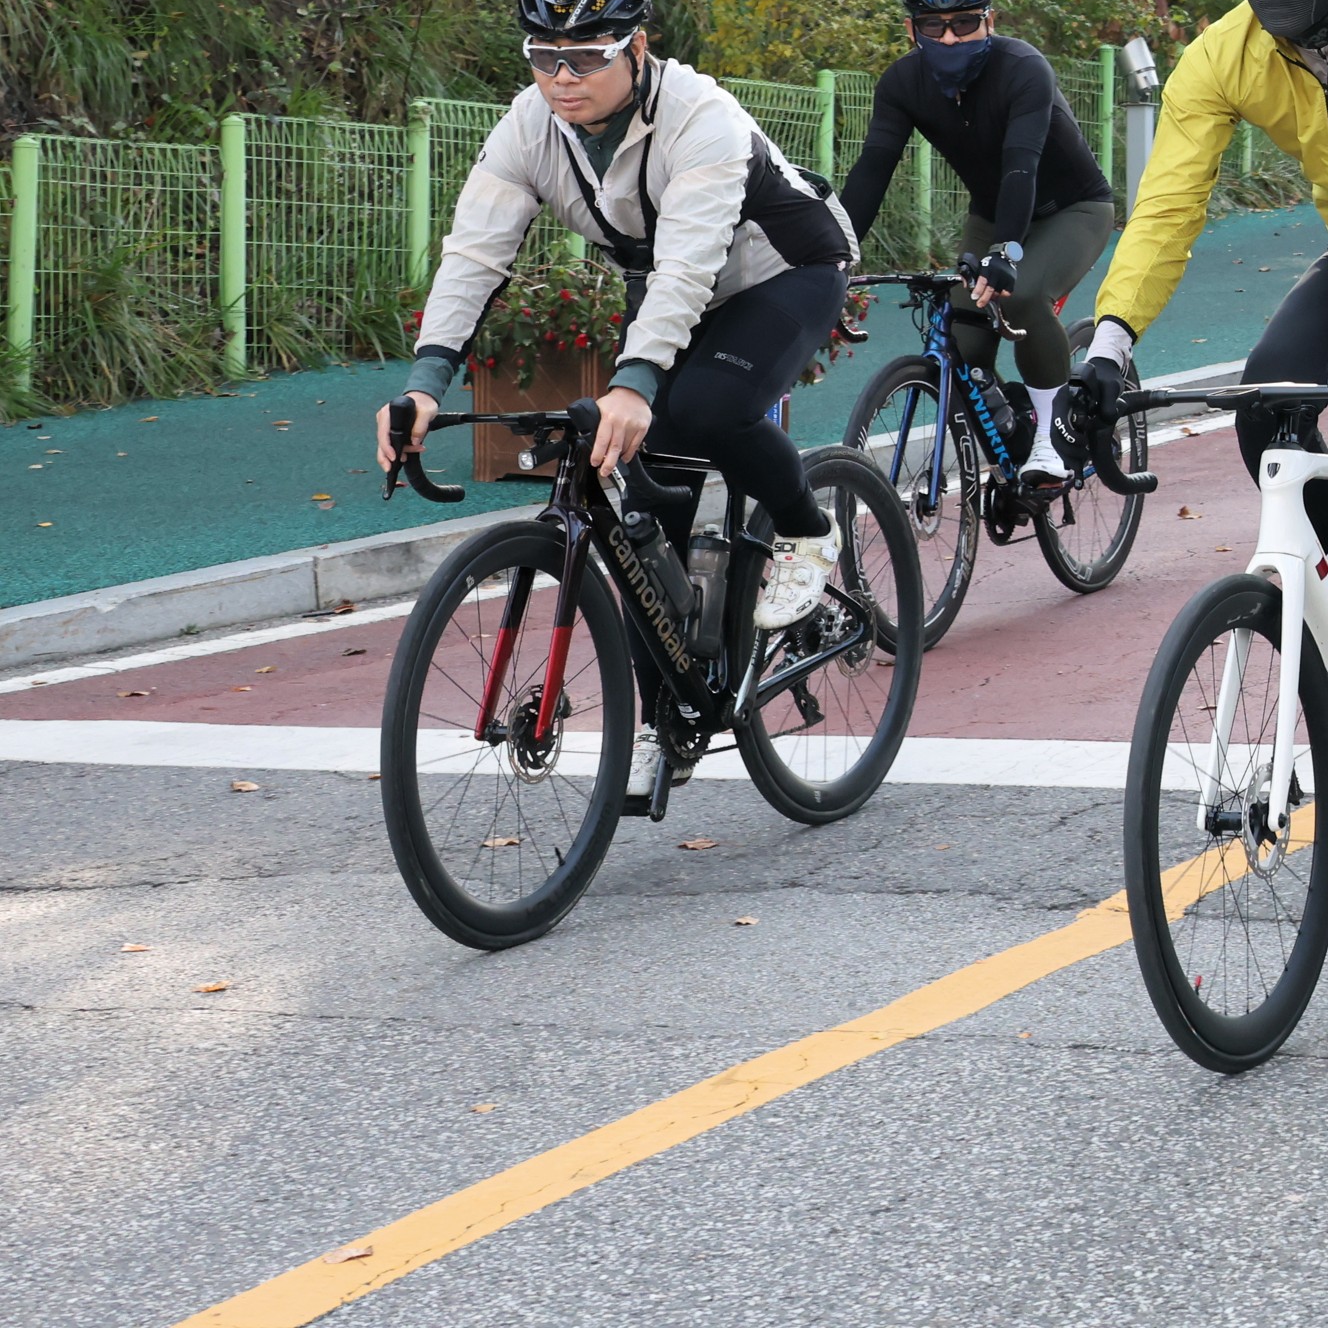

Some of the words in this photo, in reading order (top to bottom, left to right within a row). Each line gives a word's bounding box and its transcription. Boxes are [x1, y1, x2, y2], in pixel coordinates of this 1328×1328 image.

[1054, 417, 1076, 445] GIYO
[774, 541, 797, 554] SIDI
[607, 524, 692, 675] cannondale
